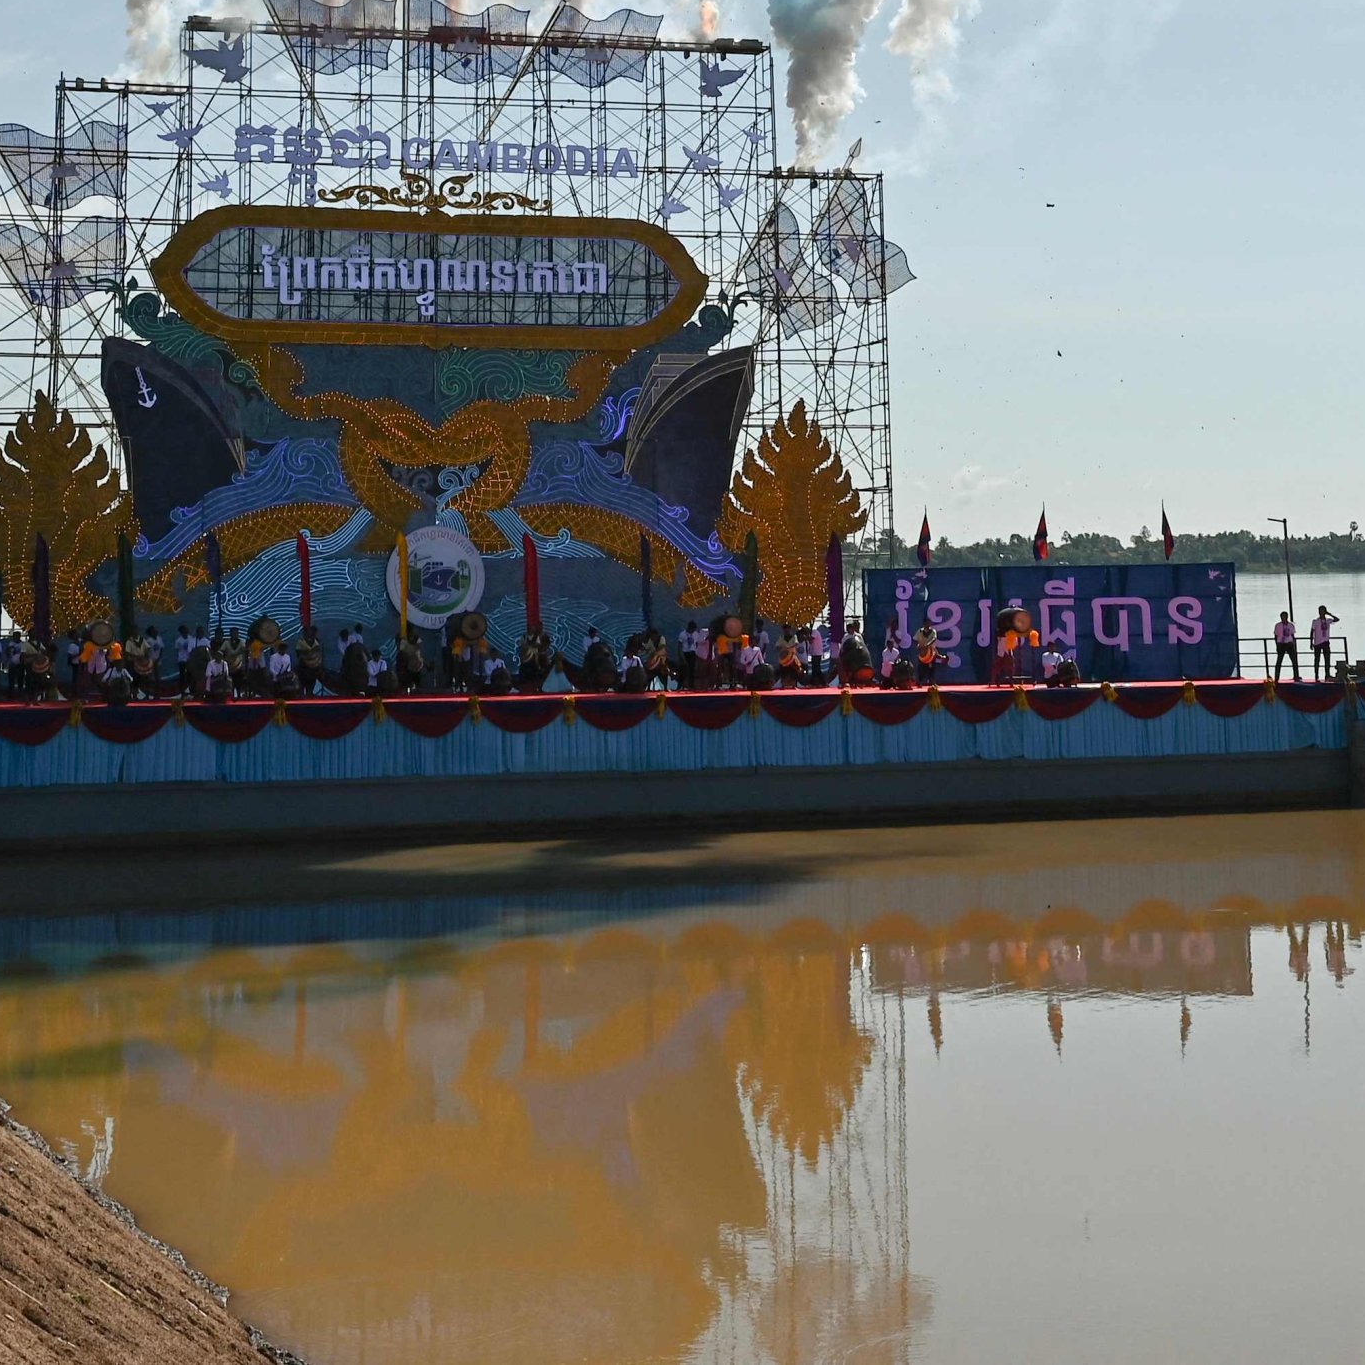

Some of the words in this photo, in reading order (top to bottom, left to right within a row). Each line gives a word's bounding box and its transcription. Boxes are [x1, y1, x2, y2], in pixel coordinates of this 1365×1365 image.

[234, 124, 392, 206] កម្ពុជា
[402, 137, 638, 178] CAMBODIA
